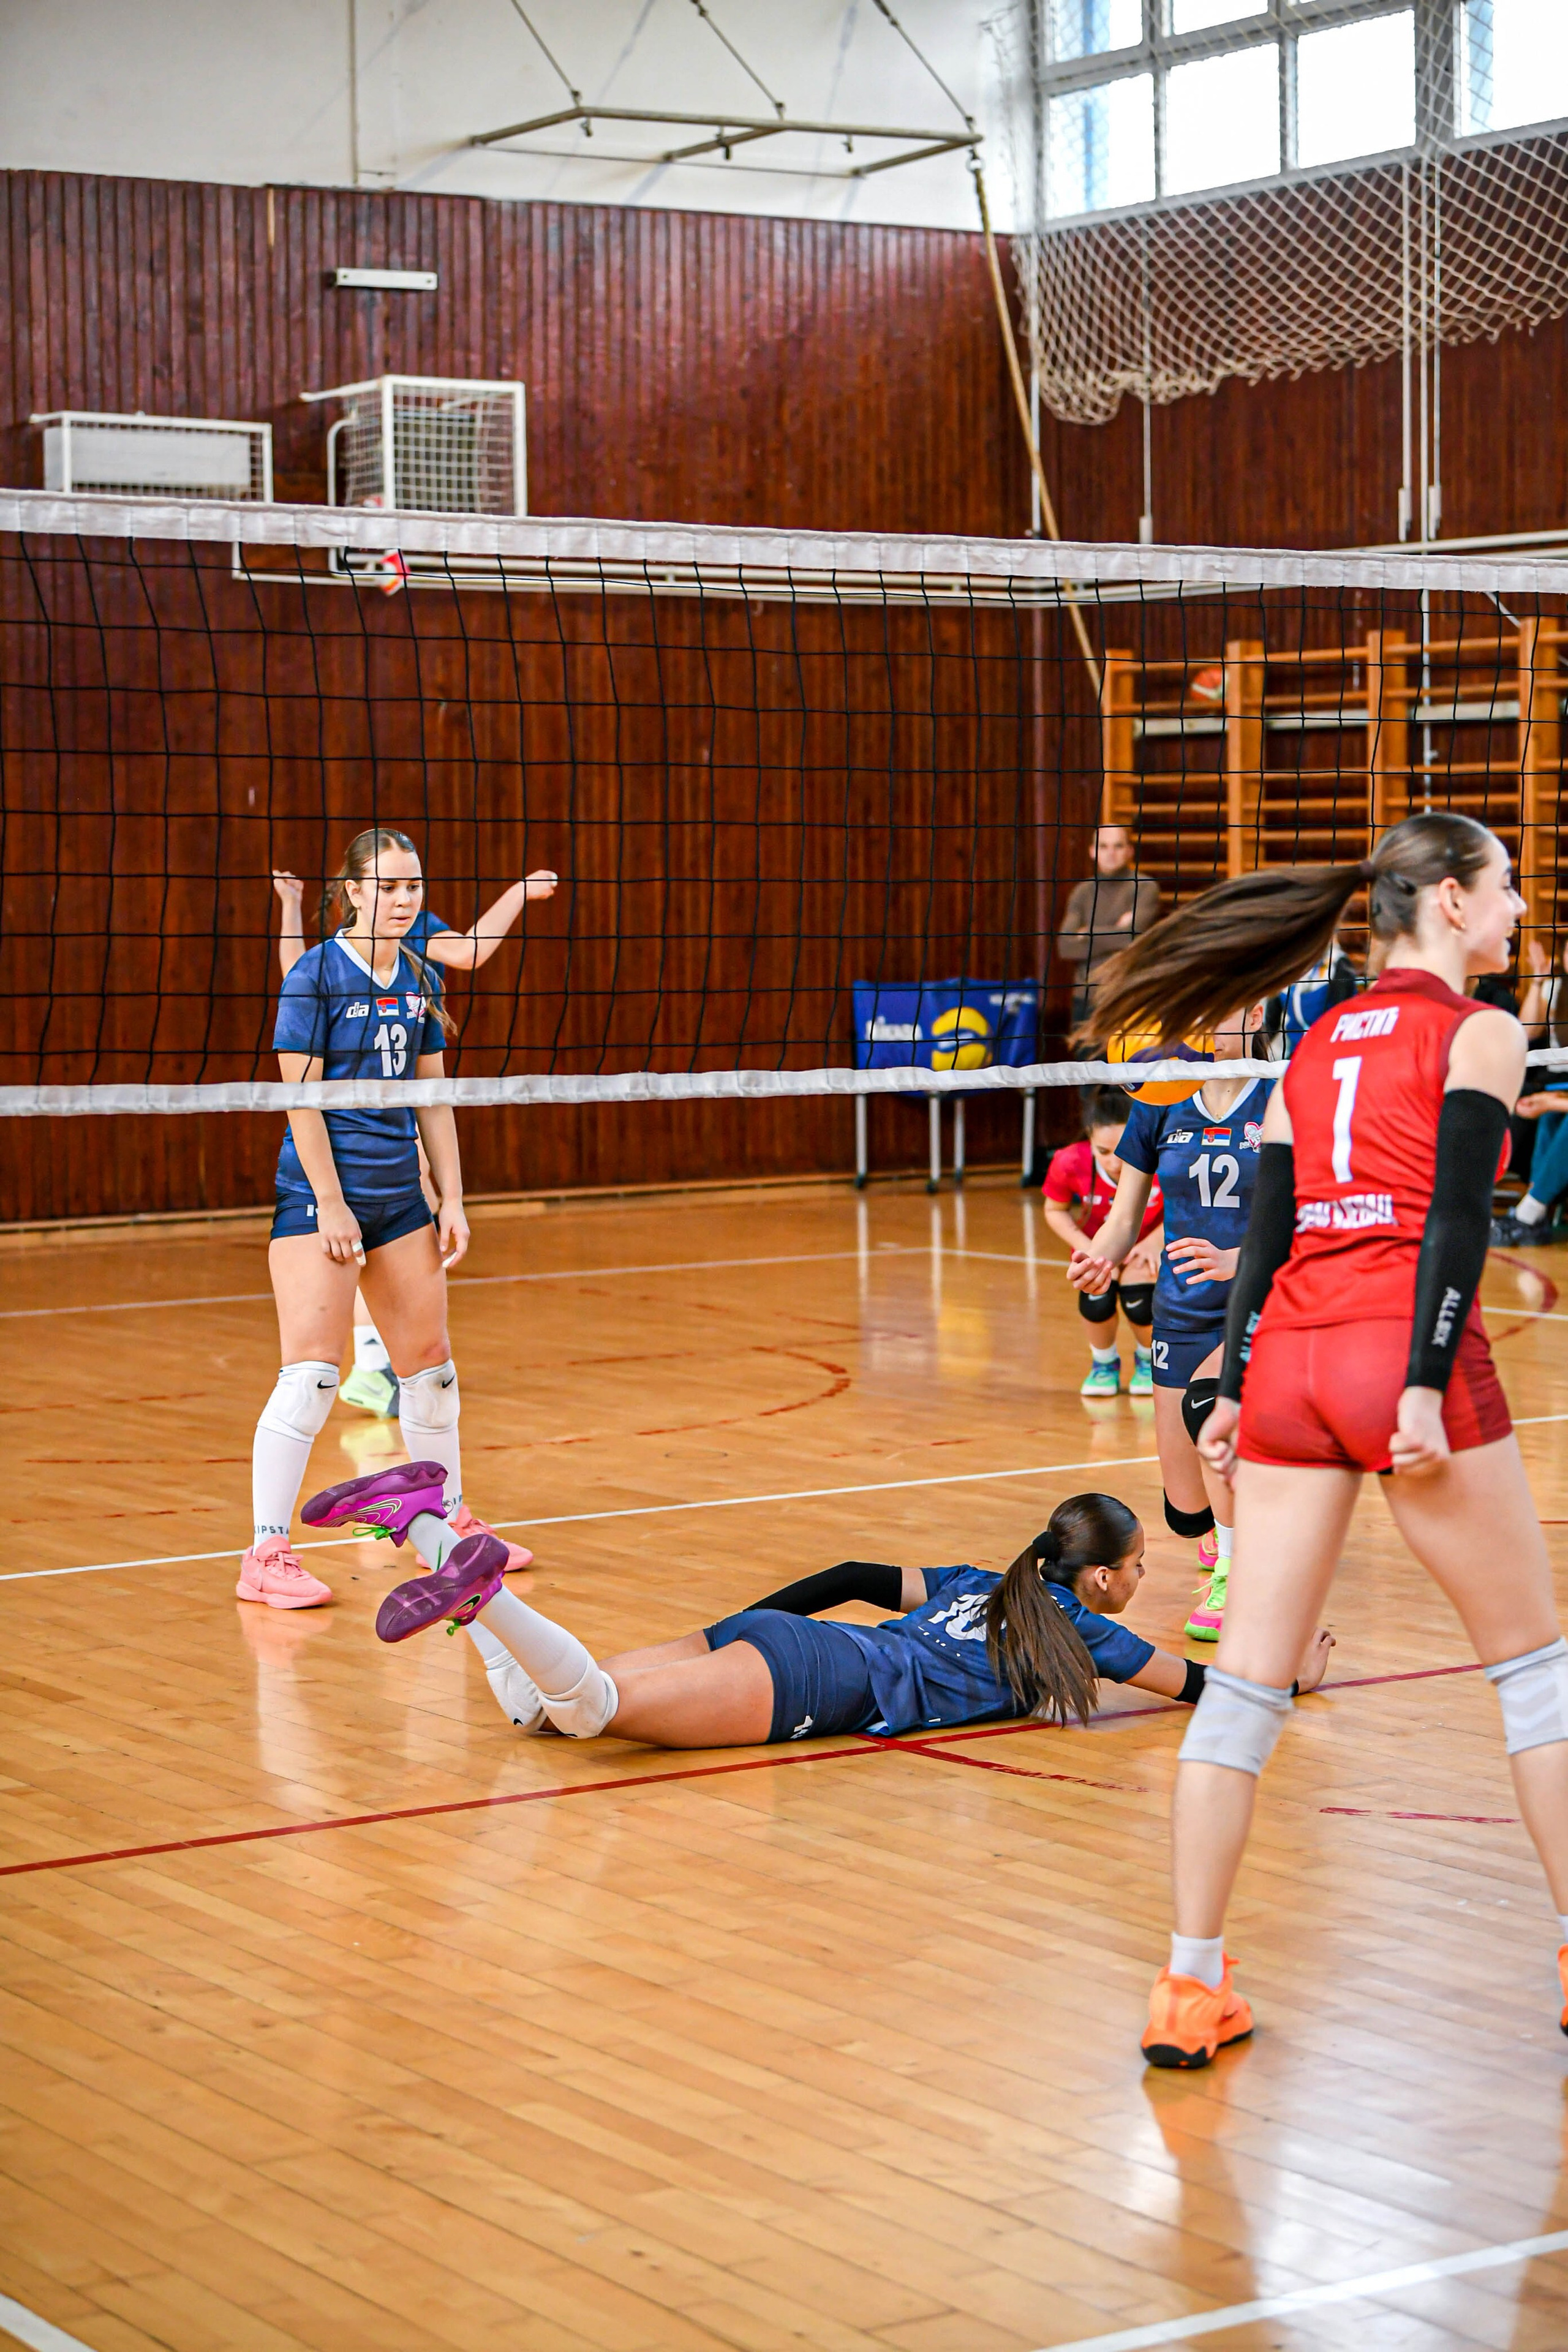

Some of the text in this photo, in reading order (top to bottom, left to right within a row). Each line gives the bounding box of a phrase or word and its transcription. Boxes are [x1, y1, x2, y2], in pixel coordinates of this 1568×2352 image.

[374, 1023, 407, 1077] 13
[1332, 1055, 1362, 1183] 1
[1188, 1153, 1240, 1208] 12
[1151, 1339, 1169, 1370] 12
